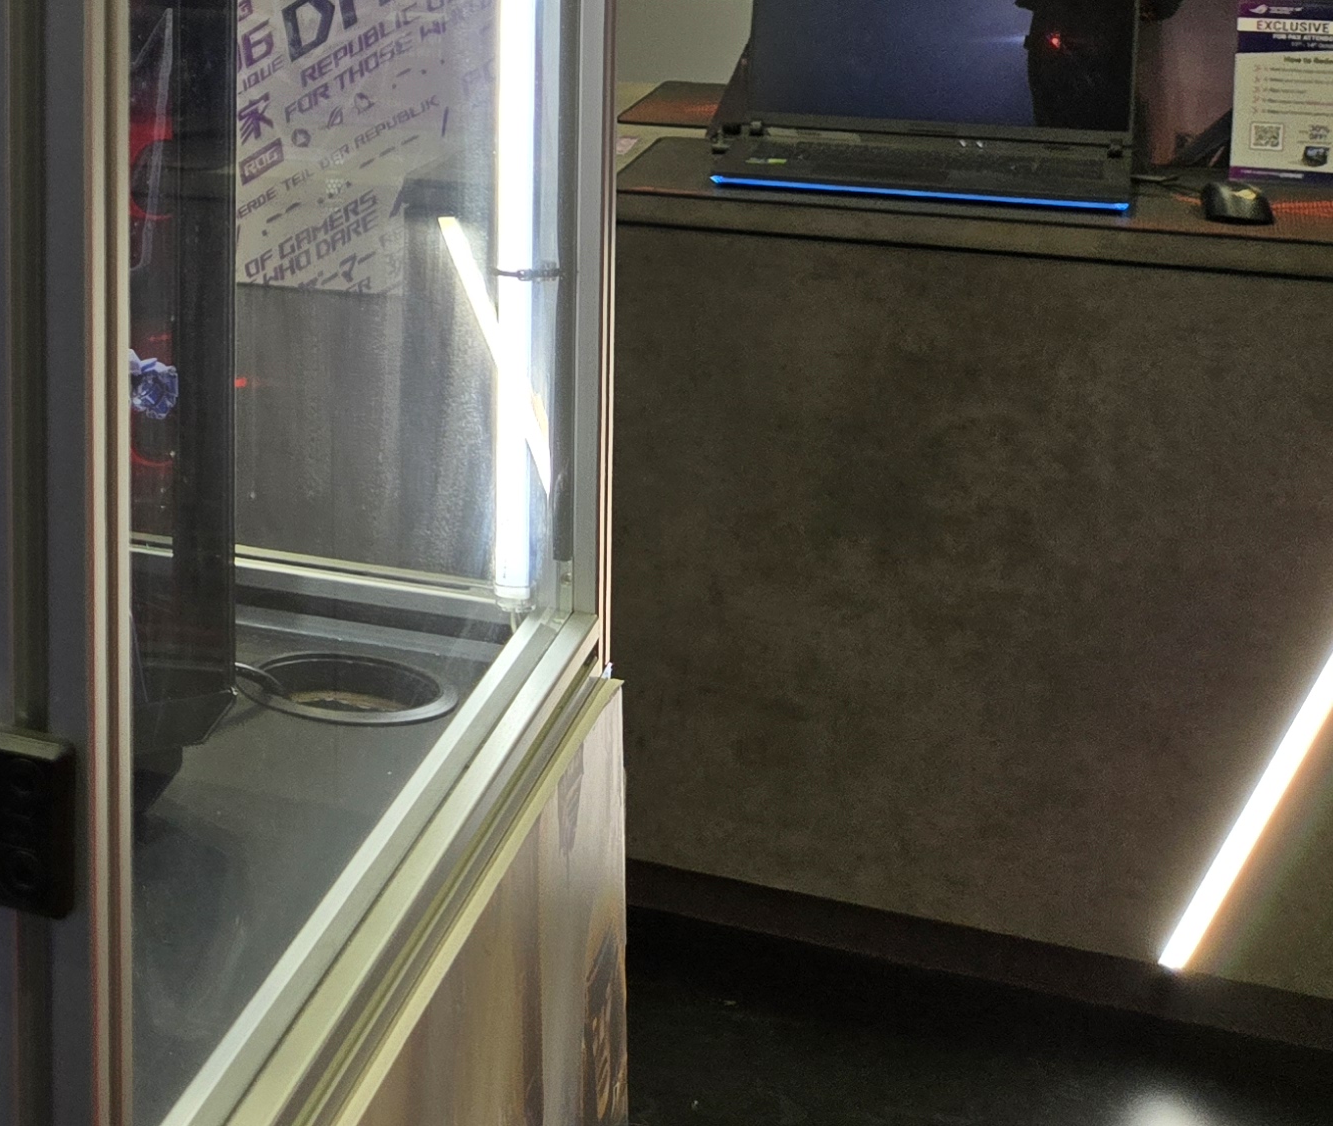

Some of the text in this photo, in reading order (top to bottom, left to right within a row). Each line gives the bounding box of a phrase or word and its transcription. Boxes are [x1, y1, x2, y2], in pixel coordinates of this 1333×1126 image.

[299, 2, 422, 88] REPUBLIC
[1256, 20, 1330, 34] EXCLUSIVE
[284, 82, 330, 123] FOR
[333, 31, 414, 92] THOSE
[237, 186, 278, 219] ERDE
[281, 168, 315, 194] TEIL
[354, 94, 441, 149] REPUBLIK
[243, 144, 281, 178] ROG
[244, 188, 379, 279] OF GAMERS
[315, 208, 380, 261] DARE
